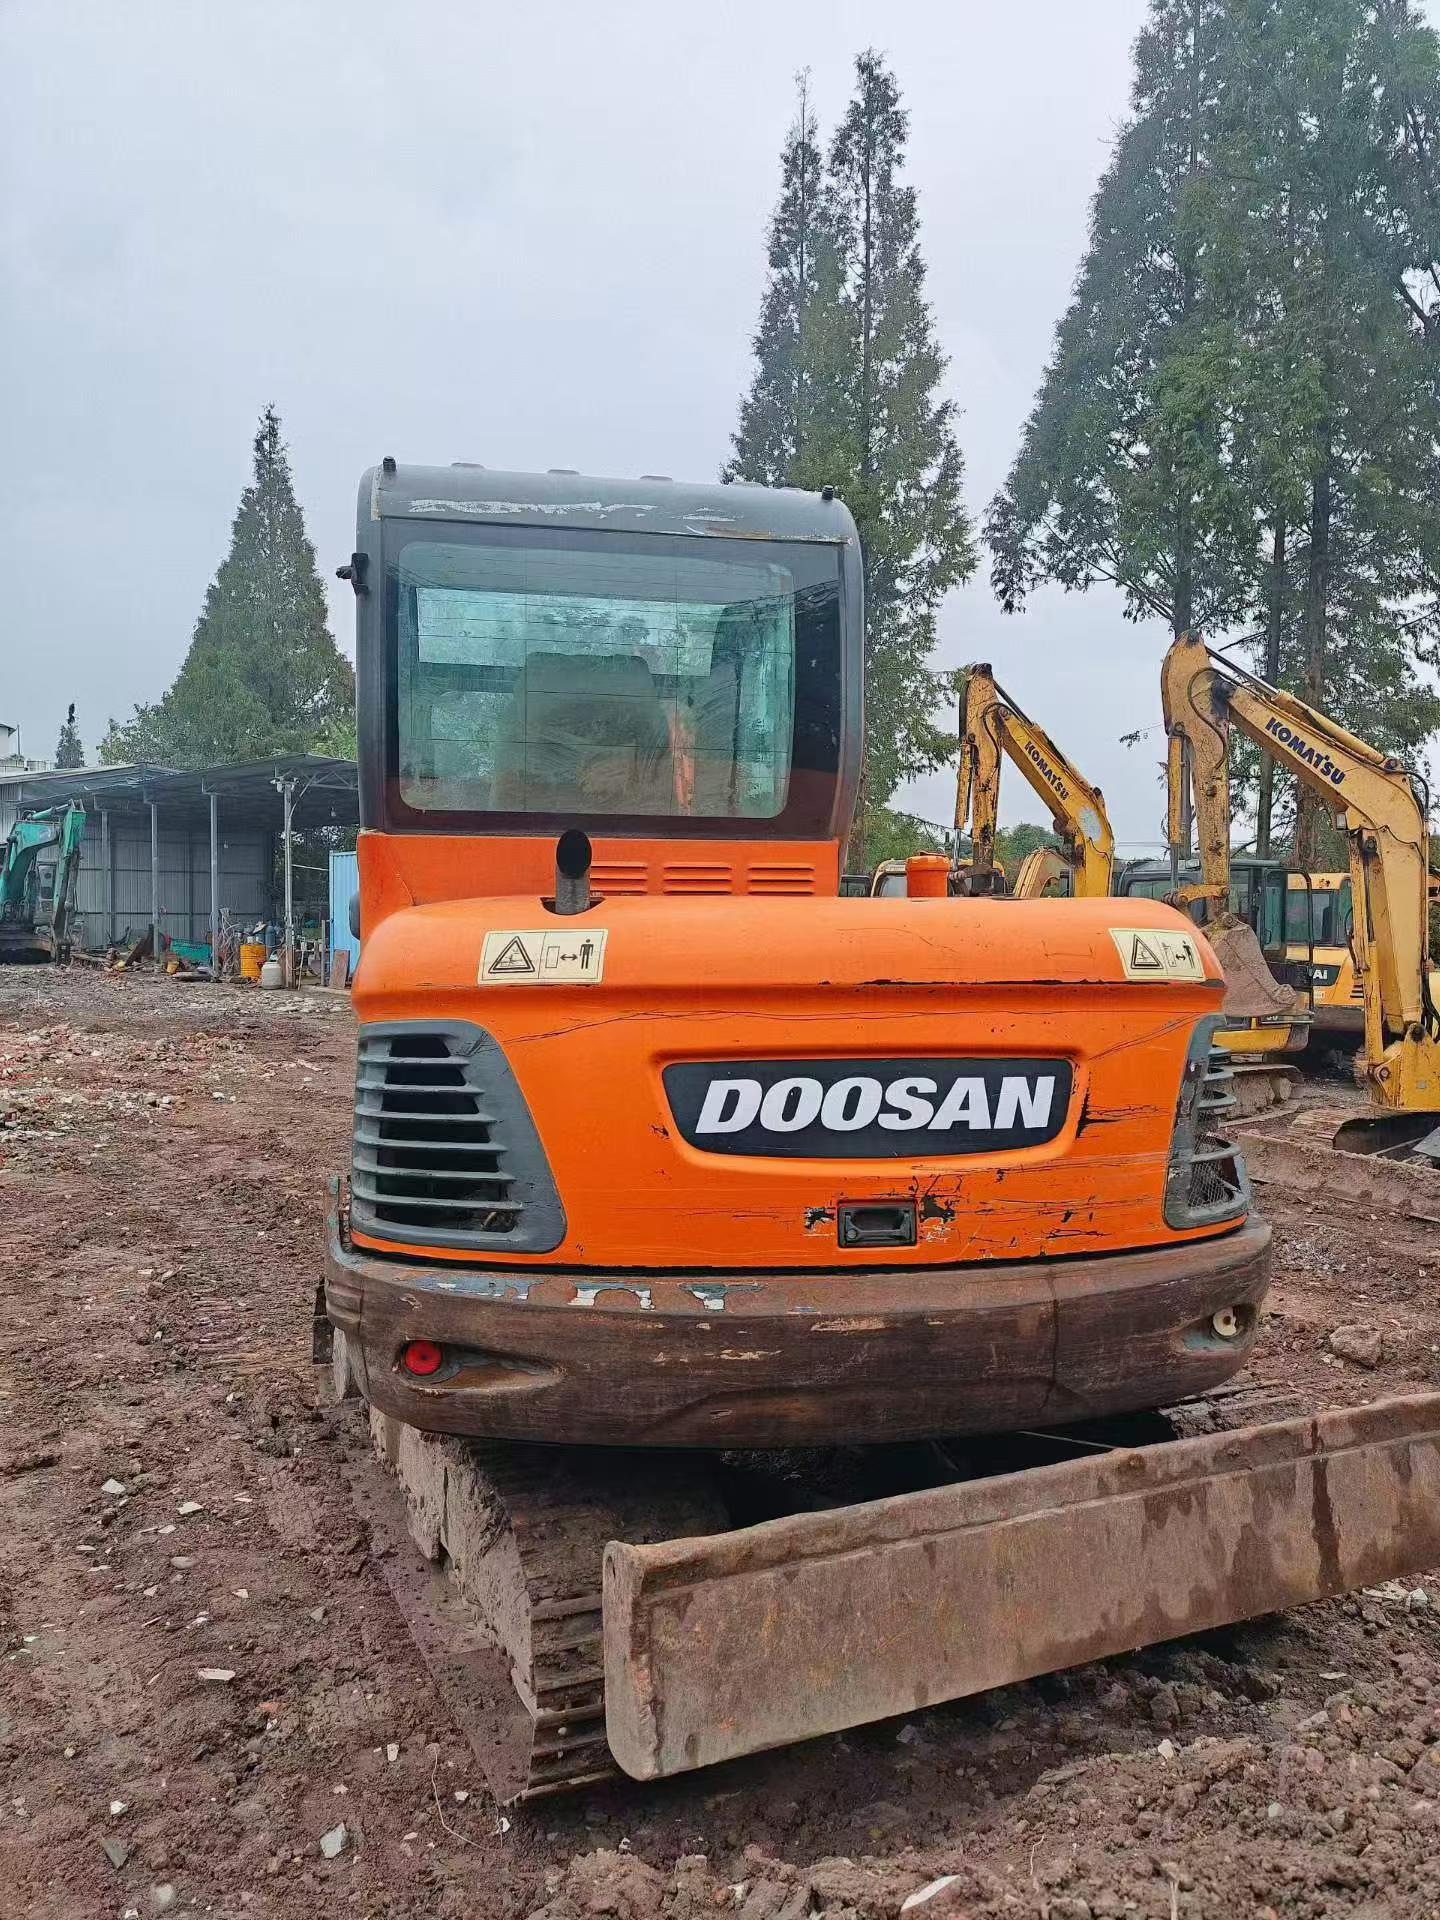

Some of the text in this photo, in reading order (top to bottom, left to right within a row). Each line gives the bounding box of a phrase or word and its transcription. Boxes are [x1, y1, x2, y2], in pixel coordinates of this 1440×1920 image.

[1024, 741, 1069, 800] KOMATSU
[1265, 717, 1346, 784] KOMATSU
[695, 1076, 1056, 1134] DOOSAN
